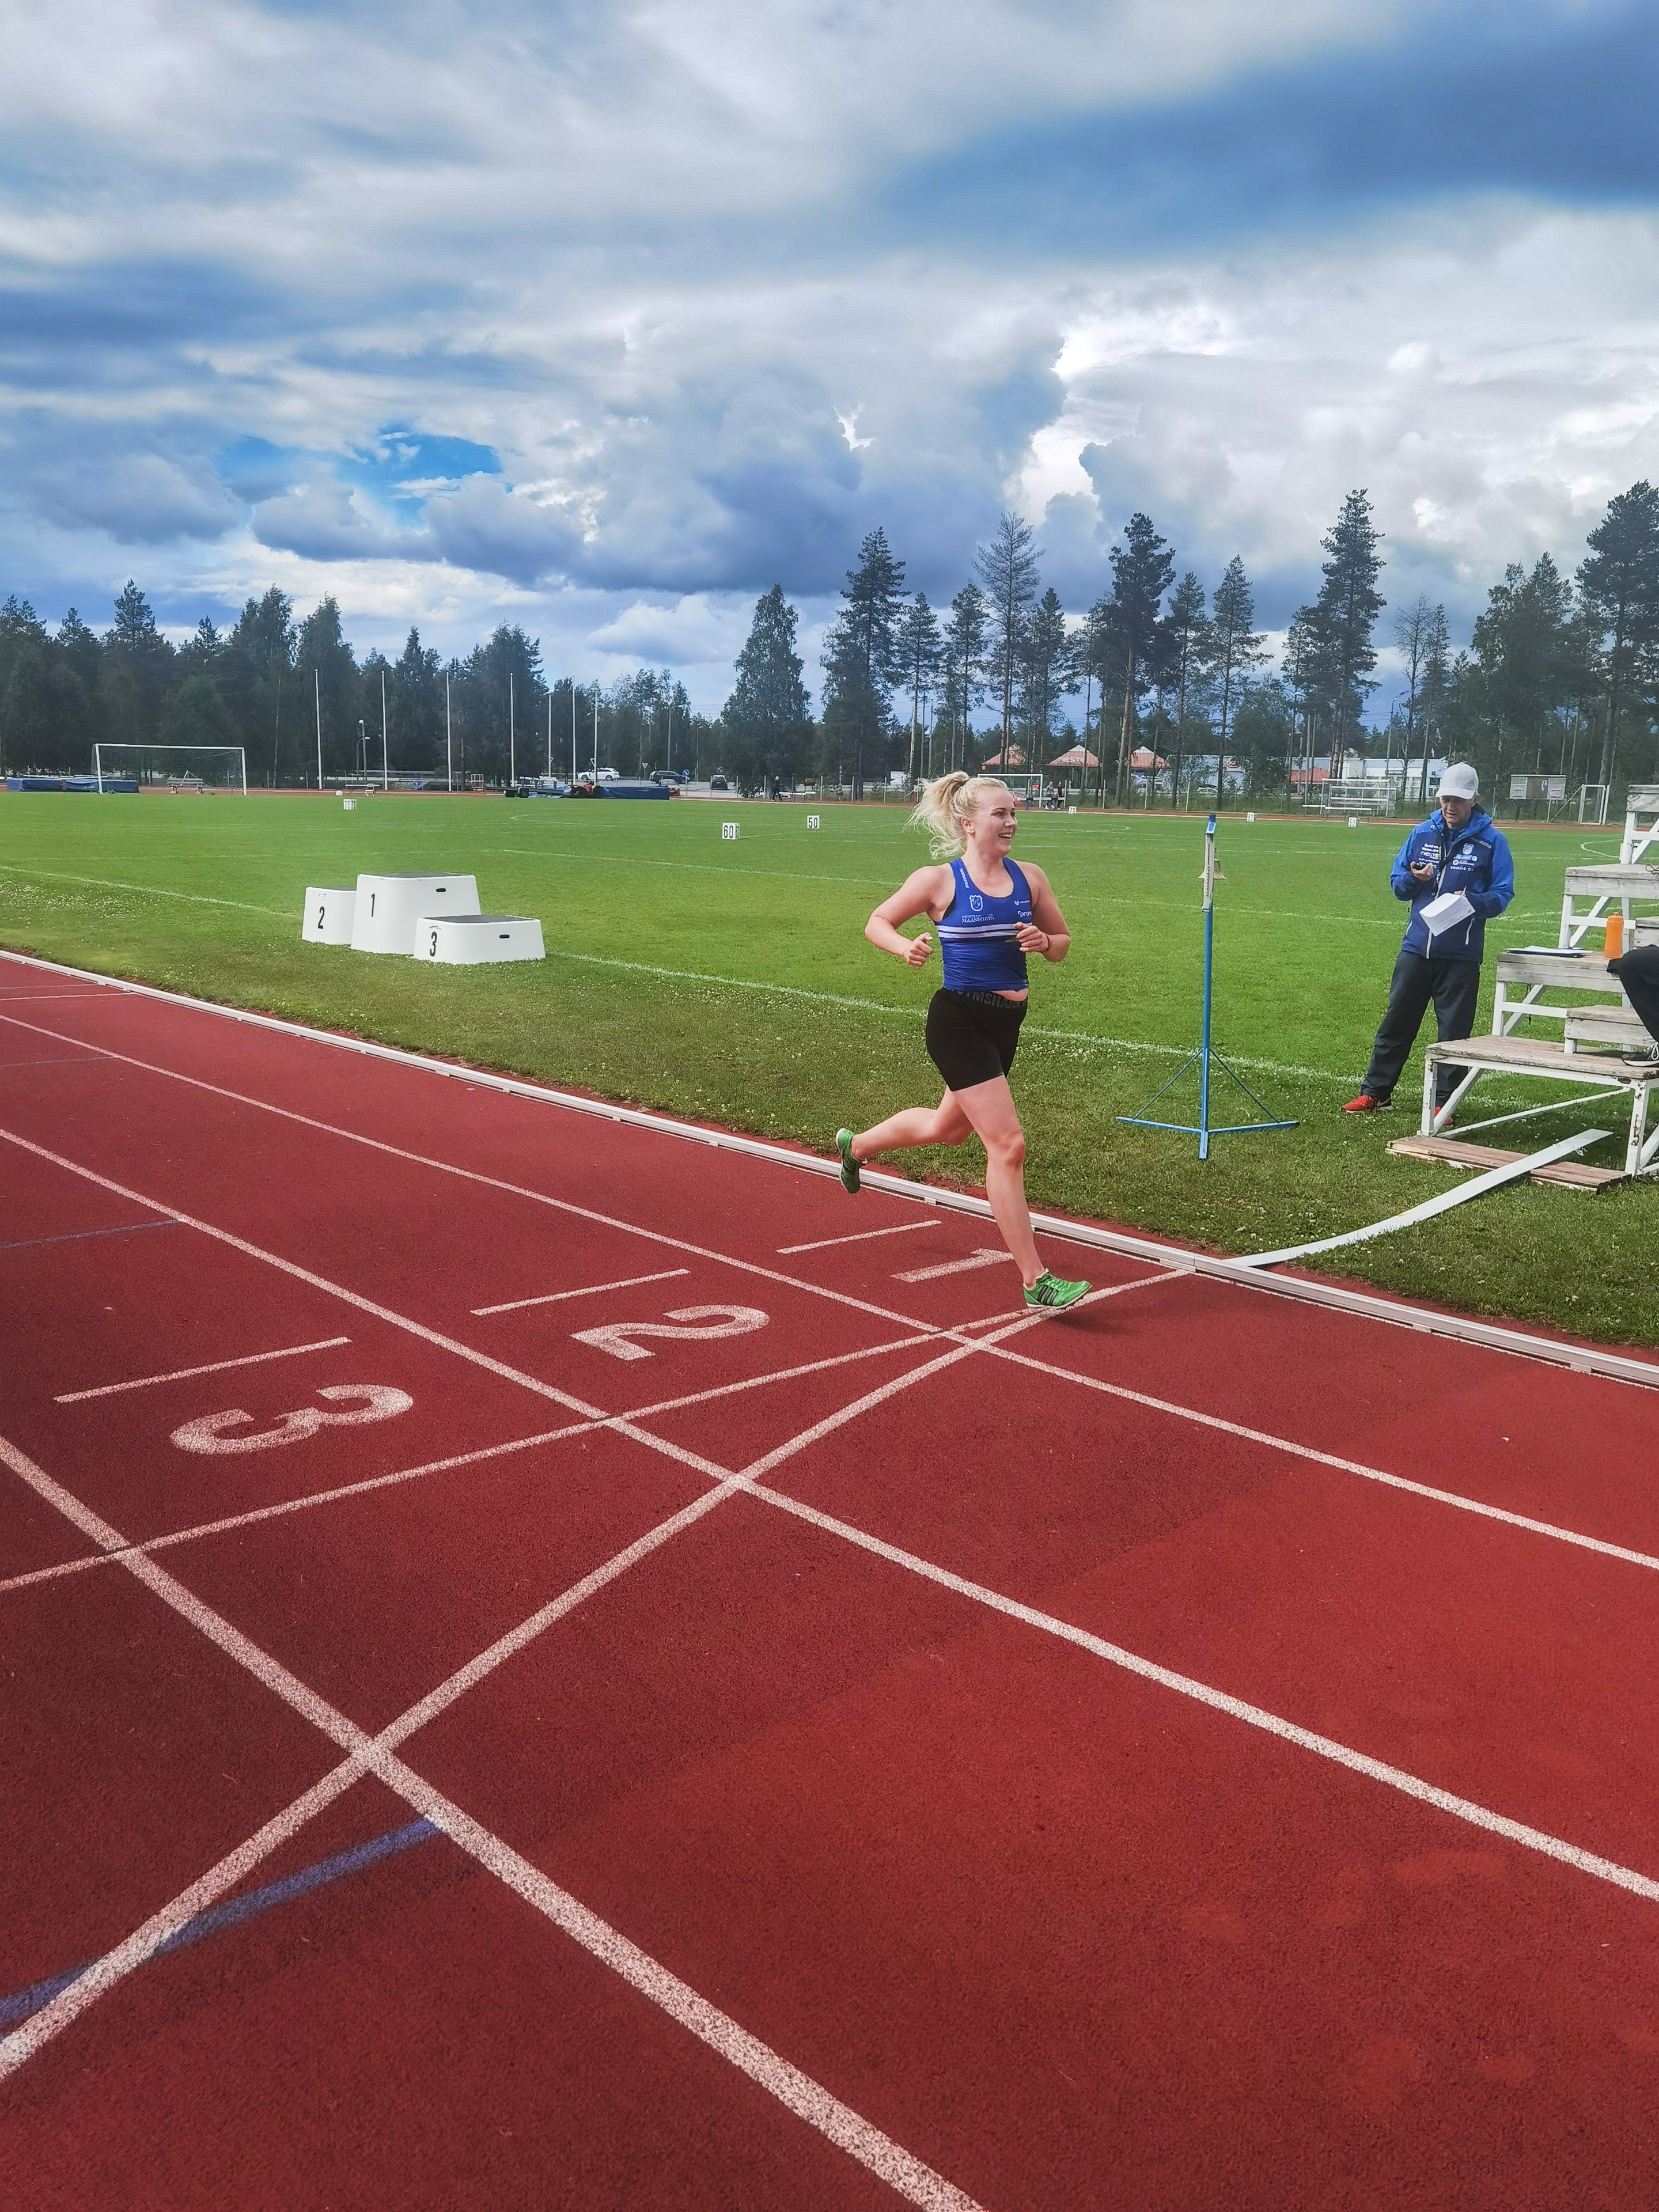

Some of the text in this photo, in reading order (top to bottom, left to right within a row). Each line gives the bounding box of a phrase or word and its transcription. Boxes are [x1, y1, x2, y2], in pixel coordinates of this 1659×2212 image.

[724, 825, 734, 839] 60
[808, 817, 818, 828] 50
[317, 906, 325, 929] 2
[371, 893, 376, 917] 1
[429, 931, 437, 957] 3
[890, 1248, 1014, 1283] 1
[570, 1304, 770, 1361] 2
[169, 1384, 414, 1455] 3
